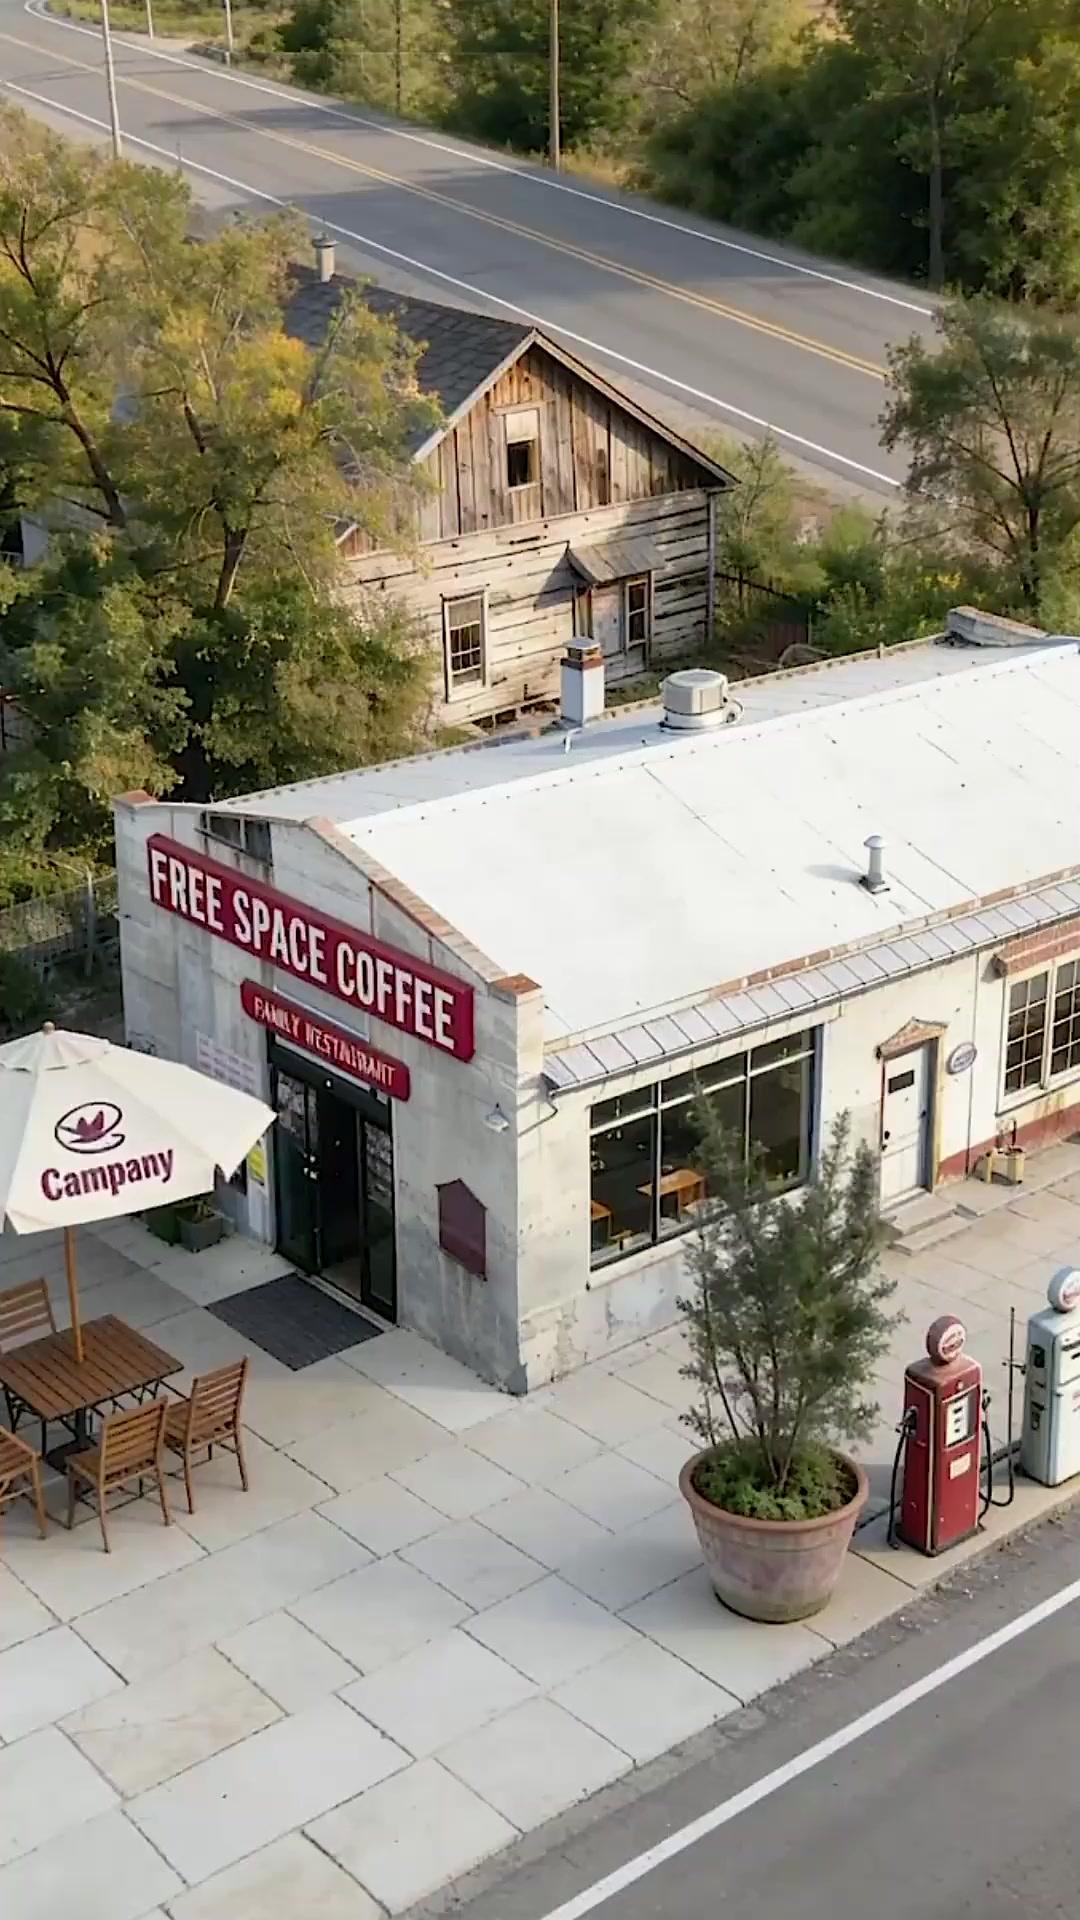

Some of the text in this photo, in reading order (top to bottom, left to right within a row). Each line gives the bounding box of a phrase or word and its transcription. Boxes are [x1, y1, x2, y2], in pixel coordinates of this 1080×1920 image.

[151, 850, 455, 1049] FREE SPACE COFFEE
[40, 1149, 174, 1201] Campany
